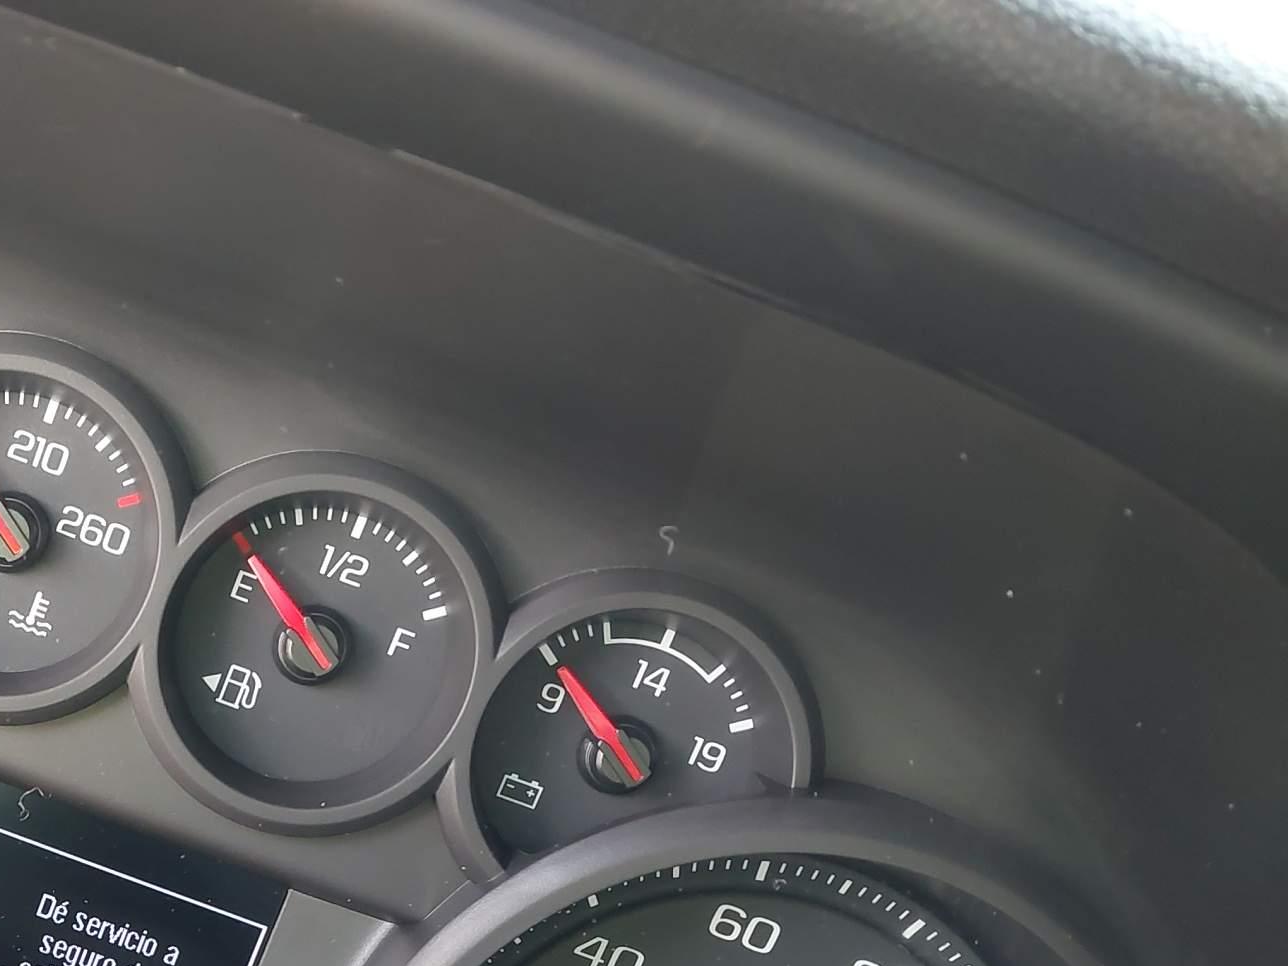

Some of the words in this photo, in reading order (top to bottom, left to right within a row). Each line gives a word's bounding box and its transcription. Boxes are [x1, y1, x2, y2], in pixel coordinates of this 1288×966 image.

[7, 430, 69, 475] 210
[55, 505, 131, 555] 260
[231, 570, 257, 602] E
[319, 544, 369, 588] 1/2
[386, 627, 415, 656] F
[631, 659, 670, 696] 14
[536, 682, 566, 714] 9
[688, 735, 726, 772] 19
[36, 893, 69, 924] Dé
[72, 911, 158, 957] servicio
[163, 946, 180, 966] a
[708, 904, 780, 954] 60
